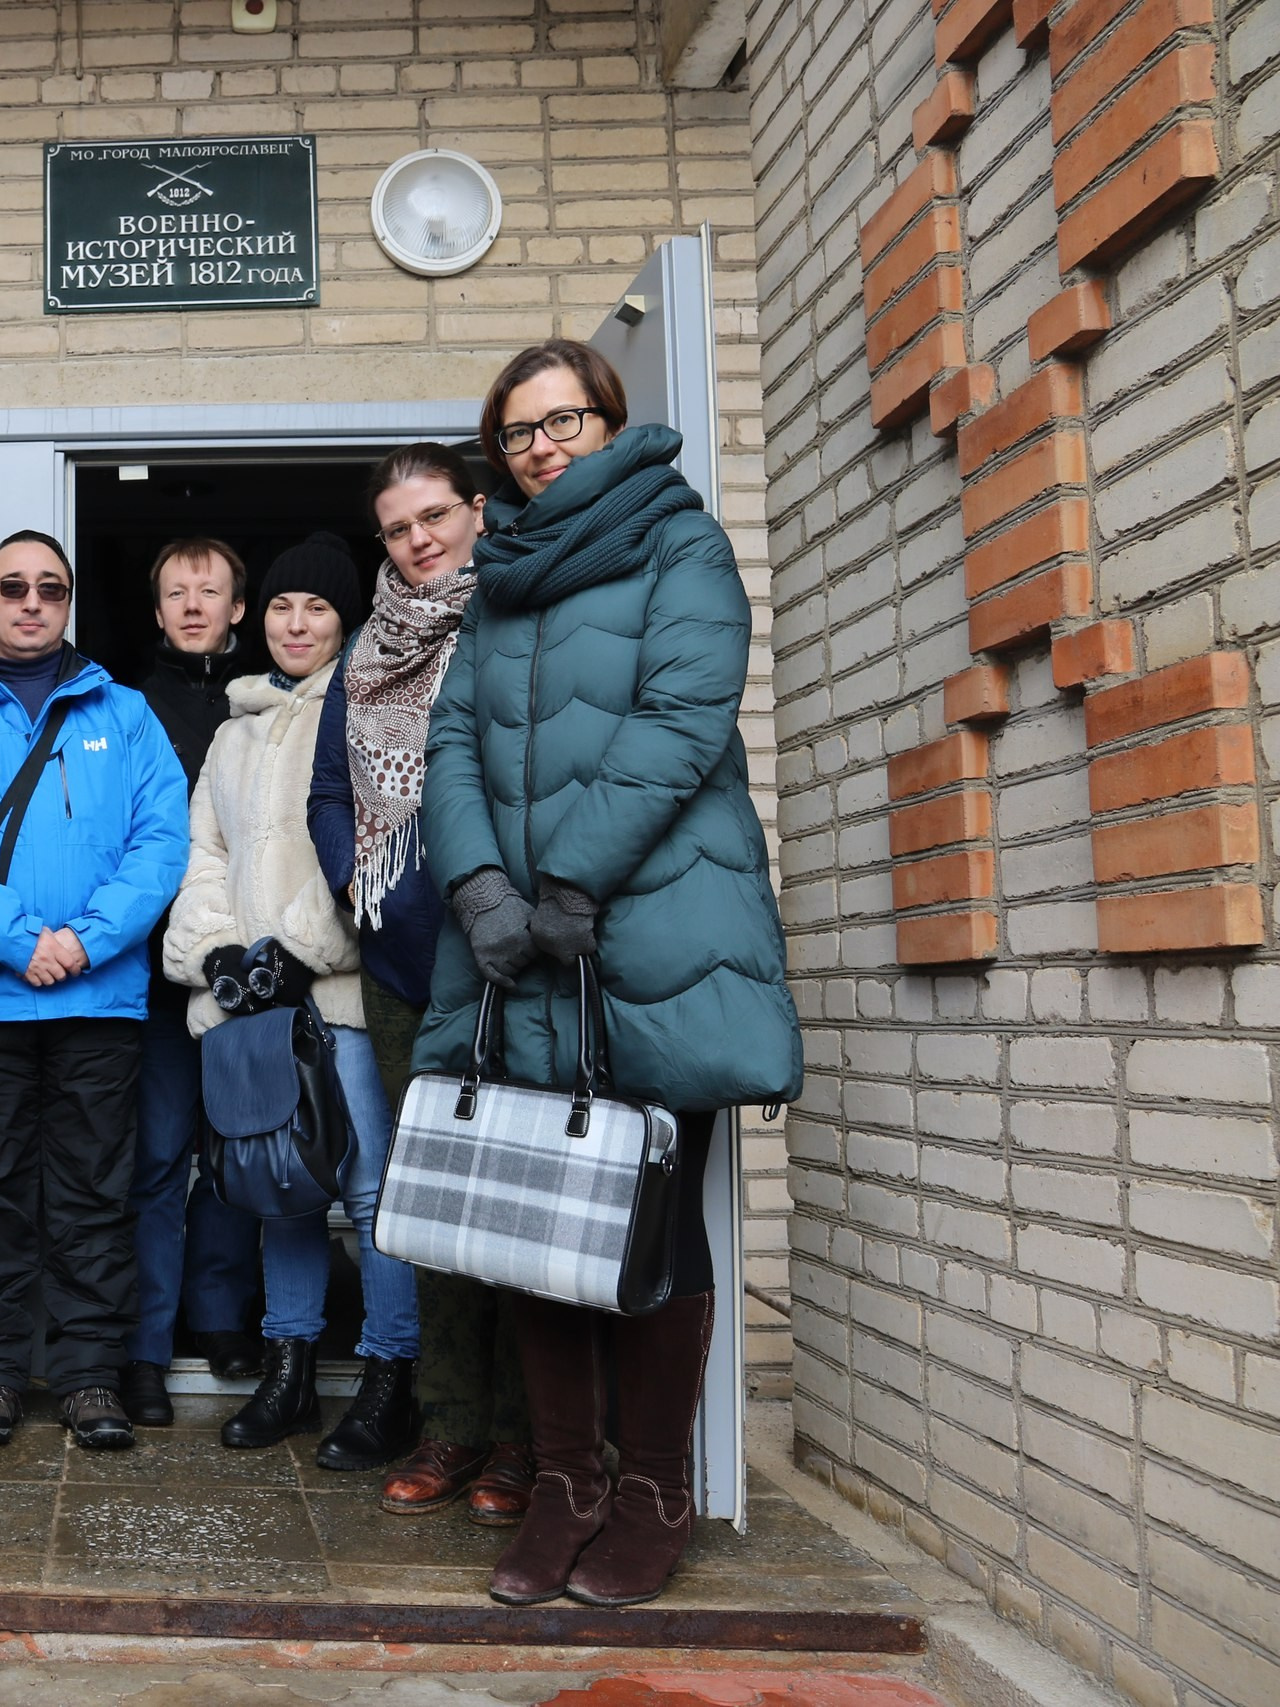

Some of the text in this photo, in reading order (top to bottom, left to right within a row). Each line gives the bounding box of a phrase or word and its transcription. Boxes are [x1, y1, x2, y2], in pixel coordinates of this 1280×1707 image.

[70, 150, 94, 161] МО
[168, 187, 190, 199] 1812
[118, 213, 256, 235] ВОЕННО-
[66, 231, 297, 261] ИСТОРИЧЕСКИЙ
[61, 259, 305, 289] МУЗЕЙ 1812 ГОДА
[82, 737, 108, 752] HH
